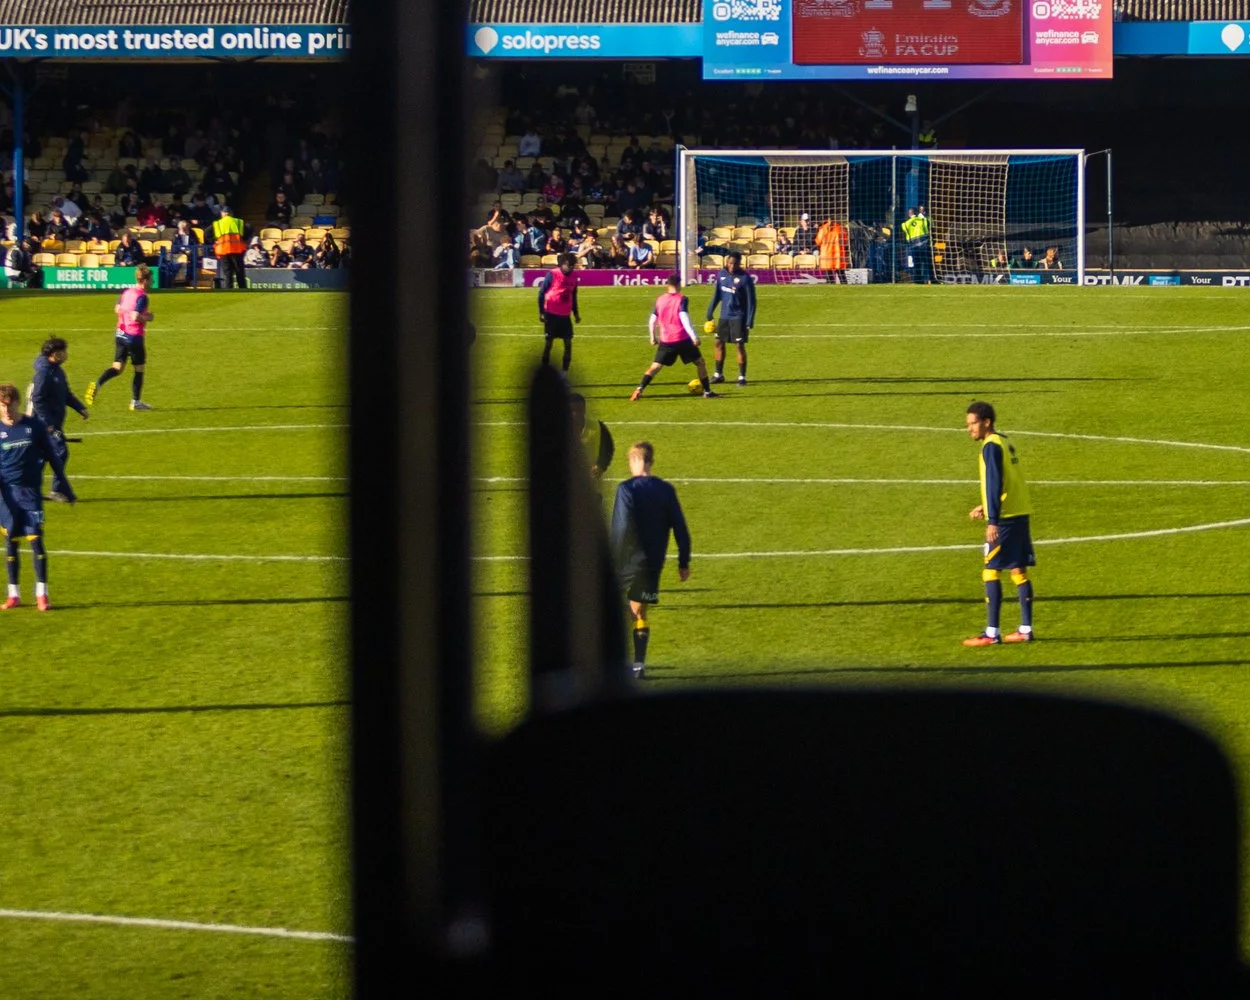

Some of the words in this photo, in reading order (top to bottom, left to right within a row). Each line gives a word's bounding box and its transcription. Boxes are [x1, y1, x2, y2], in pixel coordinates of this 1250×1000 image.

[0, 28, 48, 50] UK's
[54, 30, 118, 50] most
[123, 27, 215, 50] trusted
[220, 26, 302, 50] online
[716, 30, 760, 39] wefinance
[1035, 29, 1080, 38] wefinance
[502, 29, 601, 53] solopress
[896, 45, 917, 56] FA
[921, 45, 959, 56] CUP
[867, 66, 949, 76] wefinanceanycar.com
[57, 269, 84, 282] HERE
[87, 269, 108, 282] FOR
[613, 274, 649, 286] Kids
[1052, 275, 1073, 283] Your
[1191, 276, 1212, 284] Your
